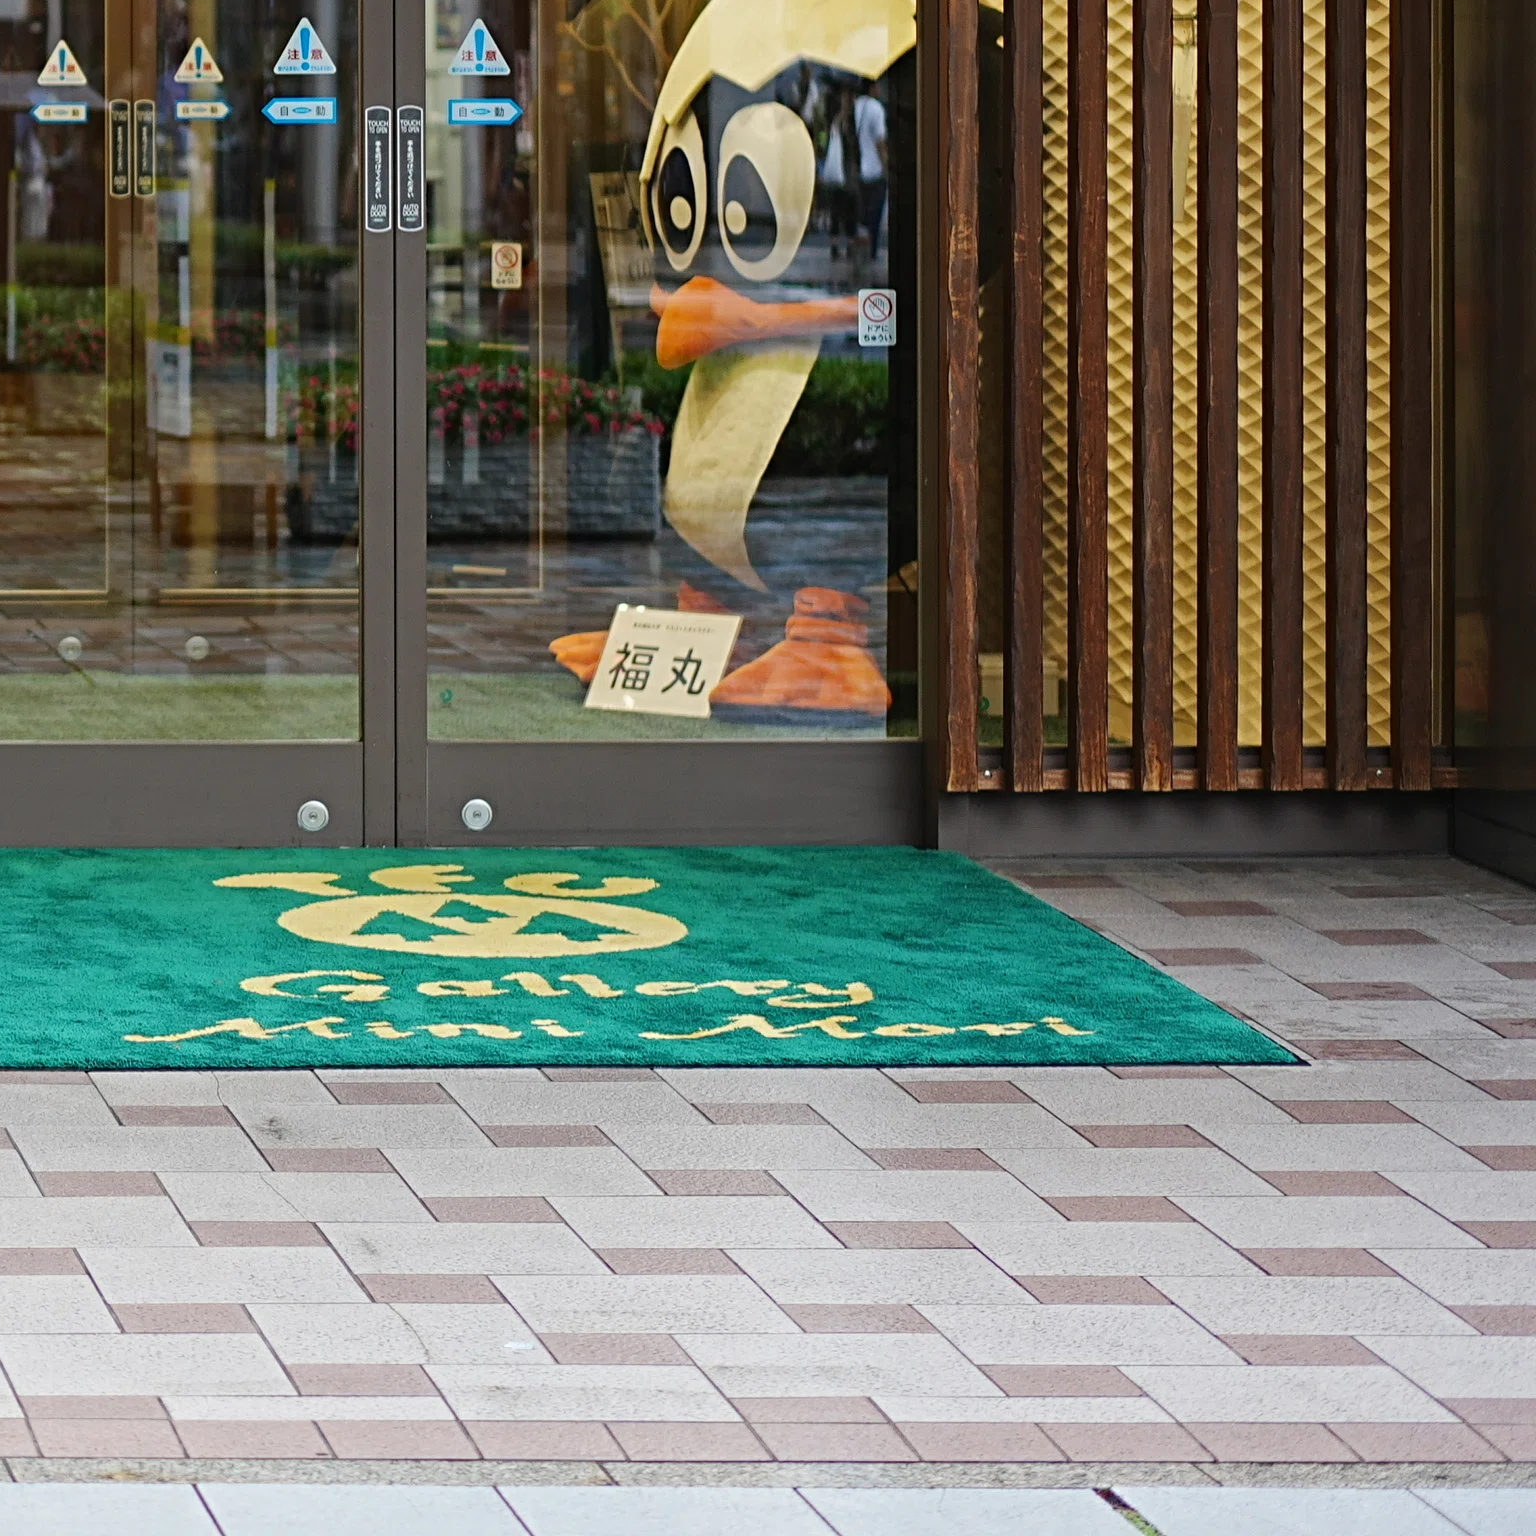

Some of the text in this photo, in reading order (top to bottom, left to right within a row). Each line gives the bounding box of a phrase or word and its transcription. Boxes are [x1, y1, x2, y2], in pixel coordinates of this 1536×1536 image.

[609, 641, 706, 696] 福丸
[239, 969, 876, 1010] Gallery
[122, 1014, 1098, 1041] Mini Mori
